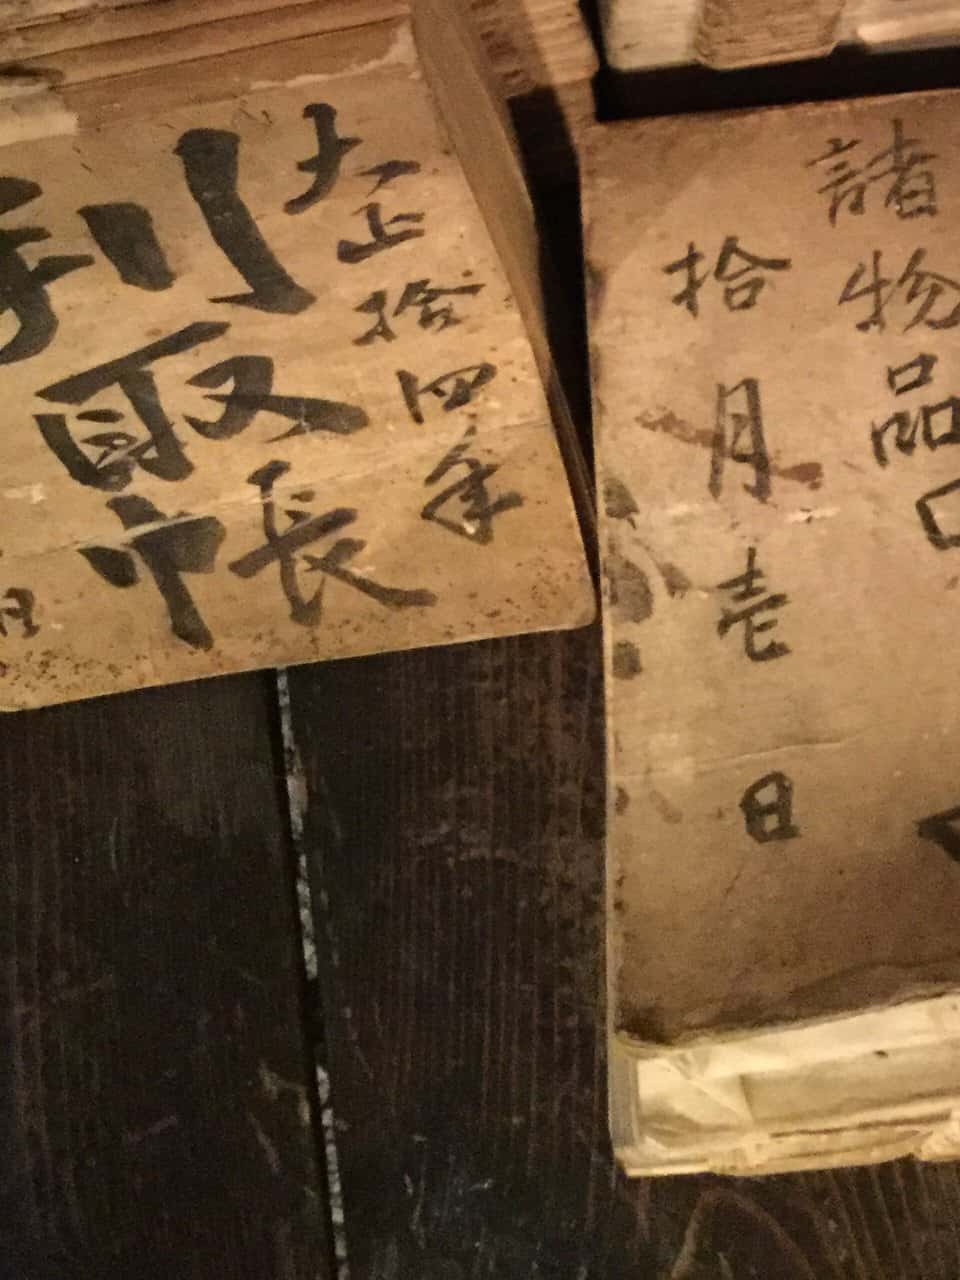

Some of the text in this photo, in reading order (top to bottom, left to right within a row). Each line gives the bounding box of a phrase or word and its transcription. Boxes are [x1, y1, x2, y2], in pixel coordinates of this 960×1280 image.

[285, 103, 524, 546] 大正拾四年
